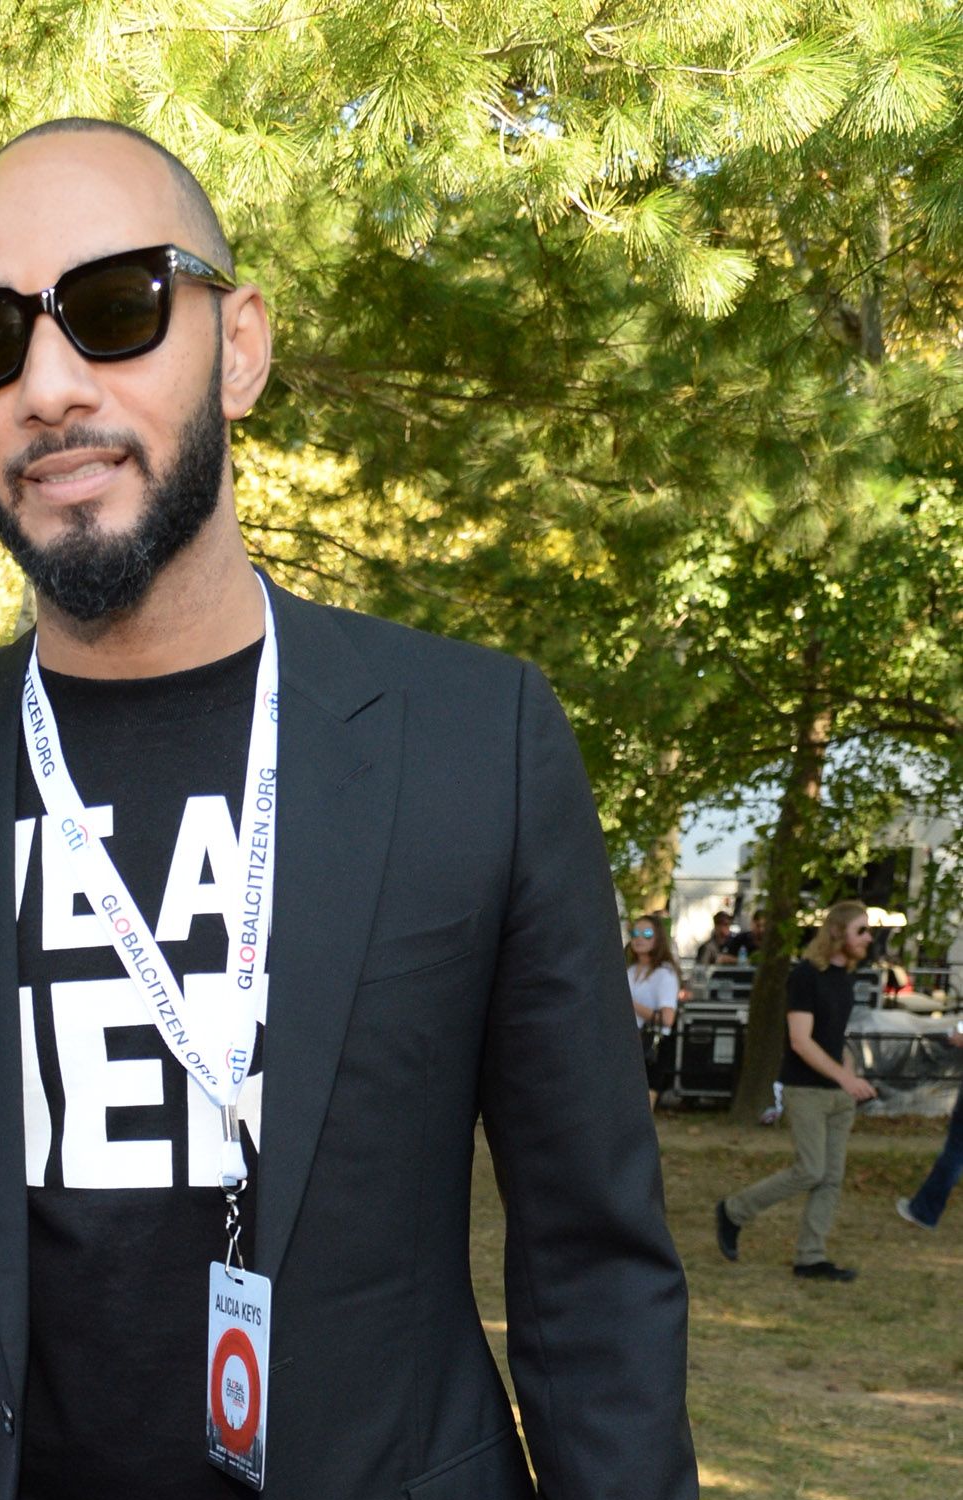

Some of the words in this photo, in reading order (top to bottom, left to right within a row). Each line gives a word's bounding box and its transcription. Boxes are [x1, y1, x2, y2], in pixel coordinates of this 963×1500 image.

[22, 663, 55, 778] ITIZEN.ORG
[61, 818, 86, 851] citi
[238, 767, 277, 990] GLOBALCITIZEN.ORG
[100, 894, 218, 1086] GLOBALCITIZEN.ORG
[228, 1049, 247, 1085] citi
[215, 1293, 240, 1319] ALICIA
[241, 1302, 262, 1326] KEYS
